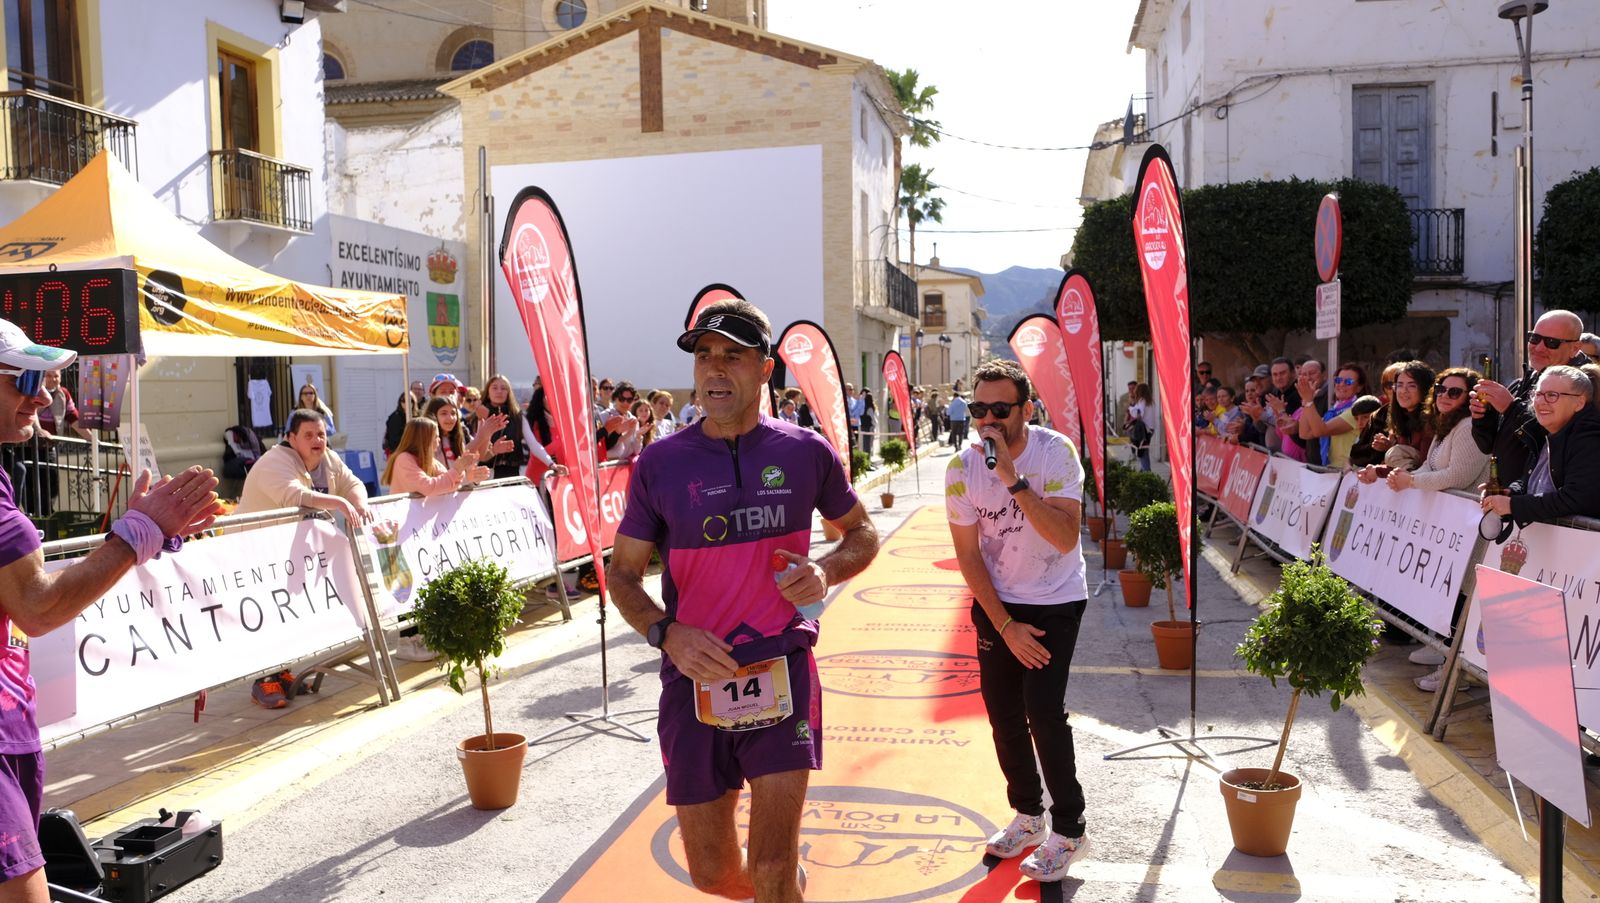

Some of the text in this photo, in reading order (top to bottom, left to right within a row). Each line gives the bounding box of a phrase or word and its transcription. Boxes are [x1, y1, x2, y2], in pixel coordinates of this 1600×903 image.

[338, 241, 421, 271] EXCELENTÍSIMO
[341, 271, 420, 297] AYUNTAMIENTO
[730, 504, 786, 532] TBM
[1363, 504, 1464, 552] AYUNTAMIENTO DE
[303, 551, 329, 571] DE
[417, 523, 547, 576] CANTORIA
[1351, 523, 1454, 597] CANTORIA
[78, 576, 344, 677] CANTORIA
[723, 677, 761, 702] 14
[823, 734, 971, 747] Ayuntamie
[824, 725, 914, 734] Cantor
[915, 814, 961, 827] LA
